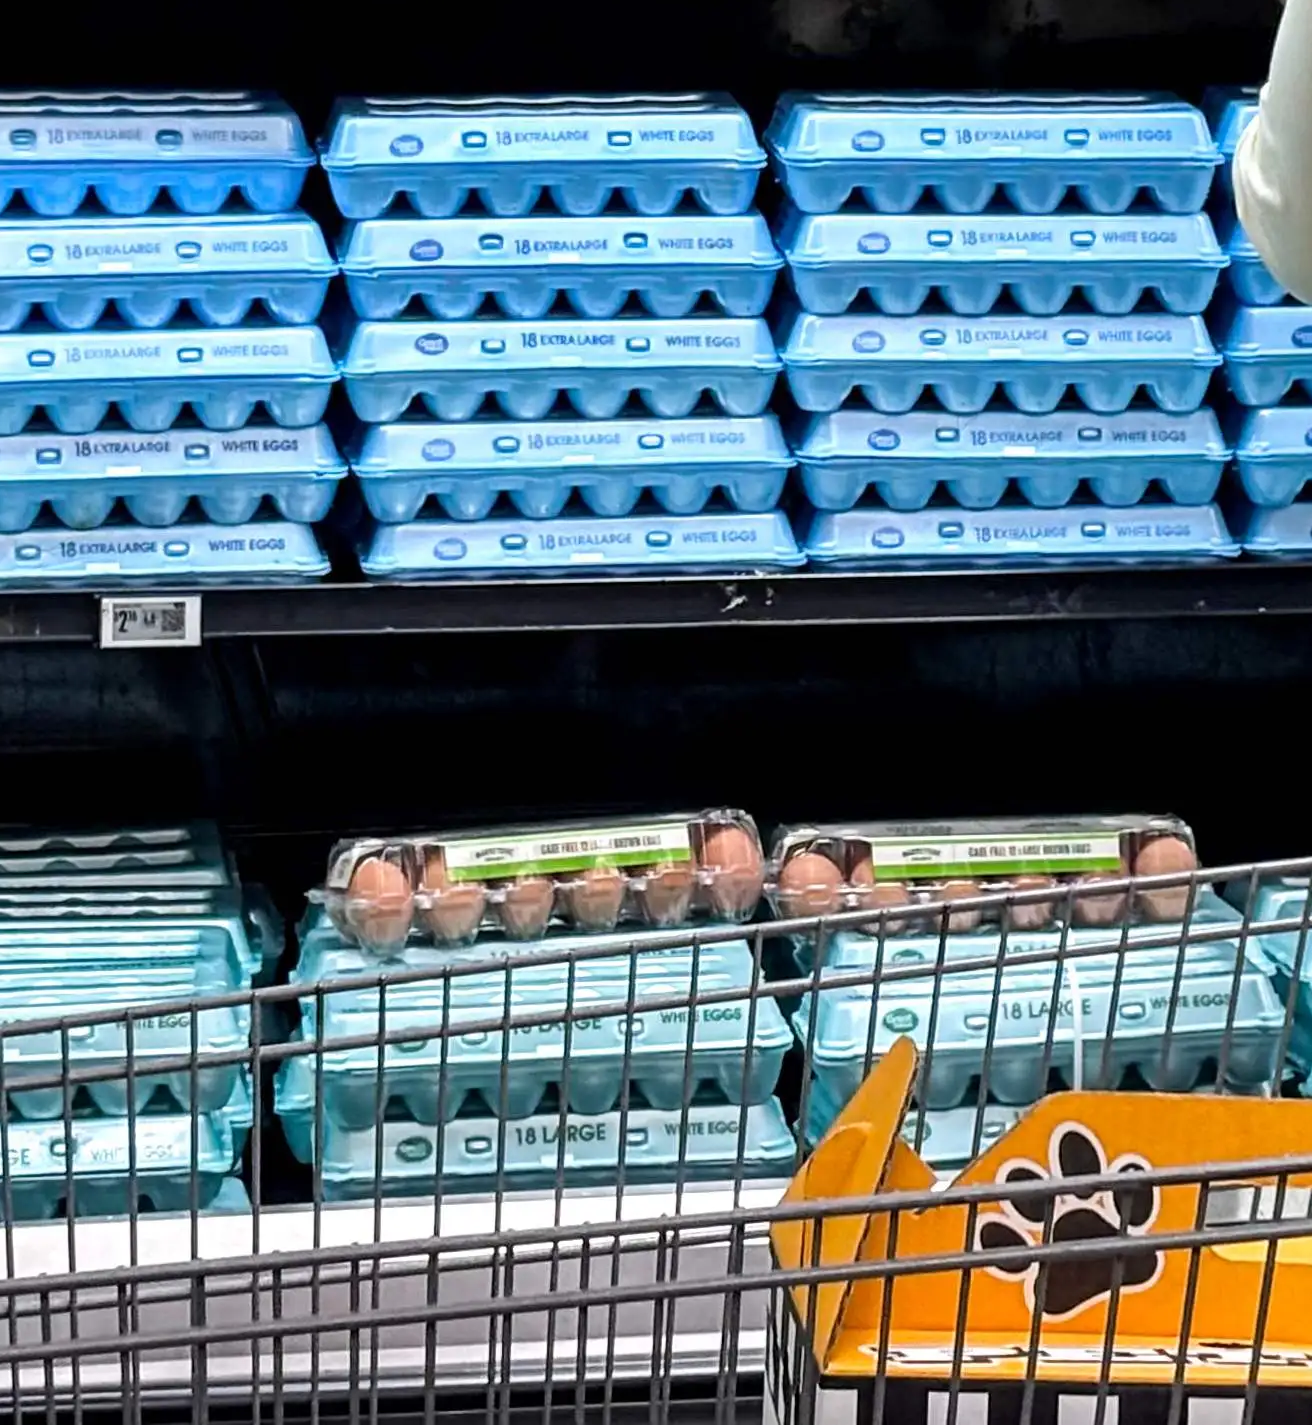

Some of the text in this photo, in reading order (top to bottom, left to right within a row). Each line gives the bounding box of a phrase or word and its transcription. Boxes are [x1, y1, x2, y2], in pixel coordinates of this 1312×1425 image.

[956, 128, 1172, 144] 18 EXTRA LARGE WHITE EGGS
[521, 333, 740, 348] 18 EXTRA LARGE WHITE EGGS
[75, 440, 298, 456] 18 EXTRA LARGE WHITE EGGS
[60, 540, 285, 557] 18 EXTRA LARGE WHITE EGGS
[515, 1128, 536, 1146] 18
